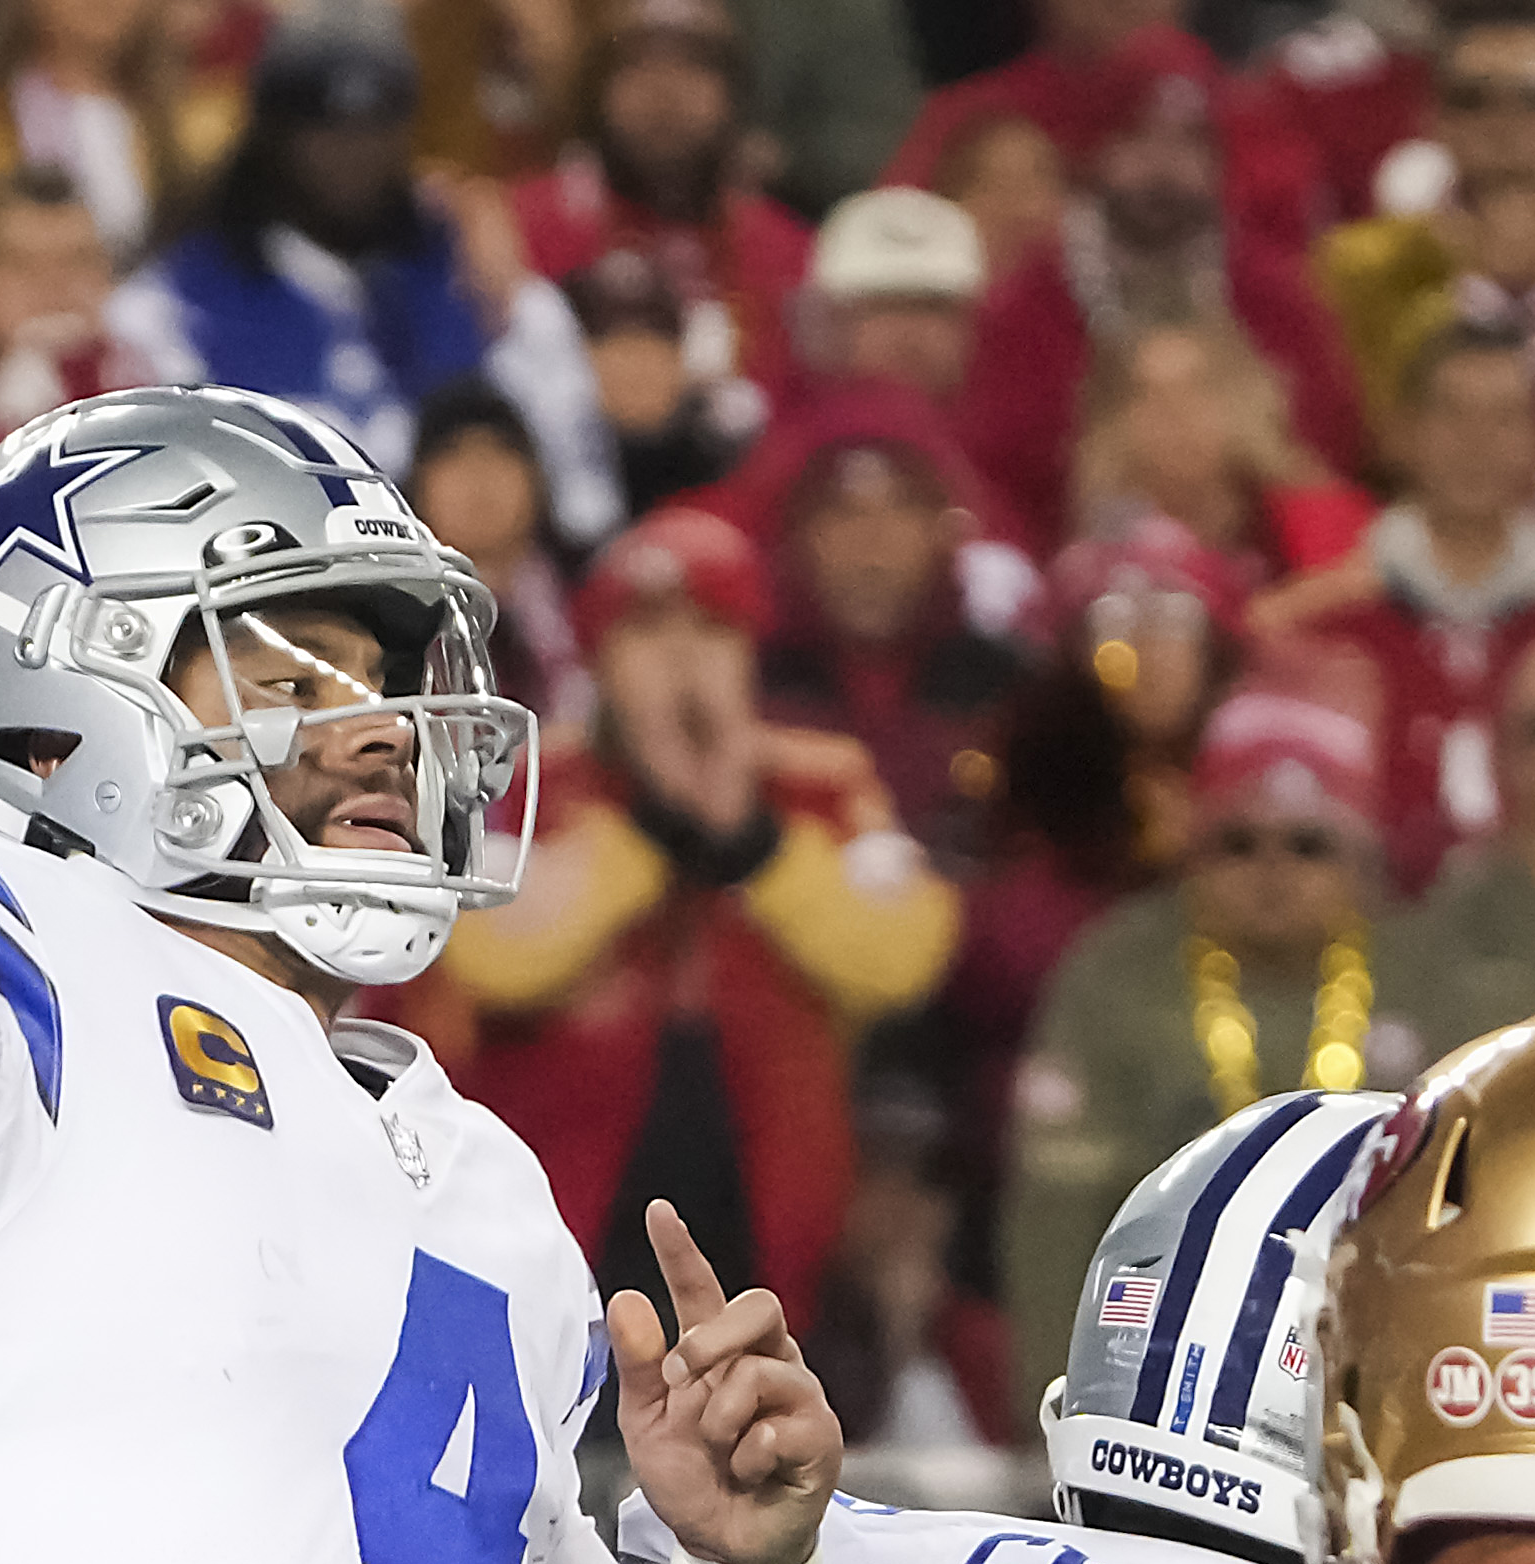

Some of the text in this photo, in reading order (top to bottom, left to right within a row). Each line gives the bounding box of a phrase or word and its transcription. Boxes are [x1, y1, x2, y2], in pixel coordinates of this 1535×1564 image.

[169, 1004, 260, 1094] C
[1432, 1364, 1480, 1403] JM
[1091, 1438, 1263, 1515] COWBOYS
